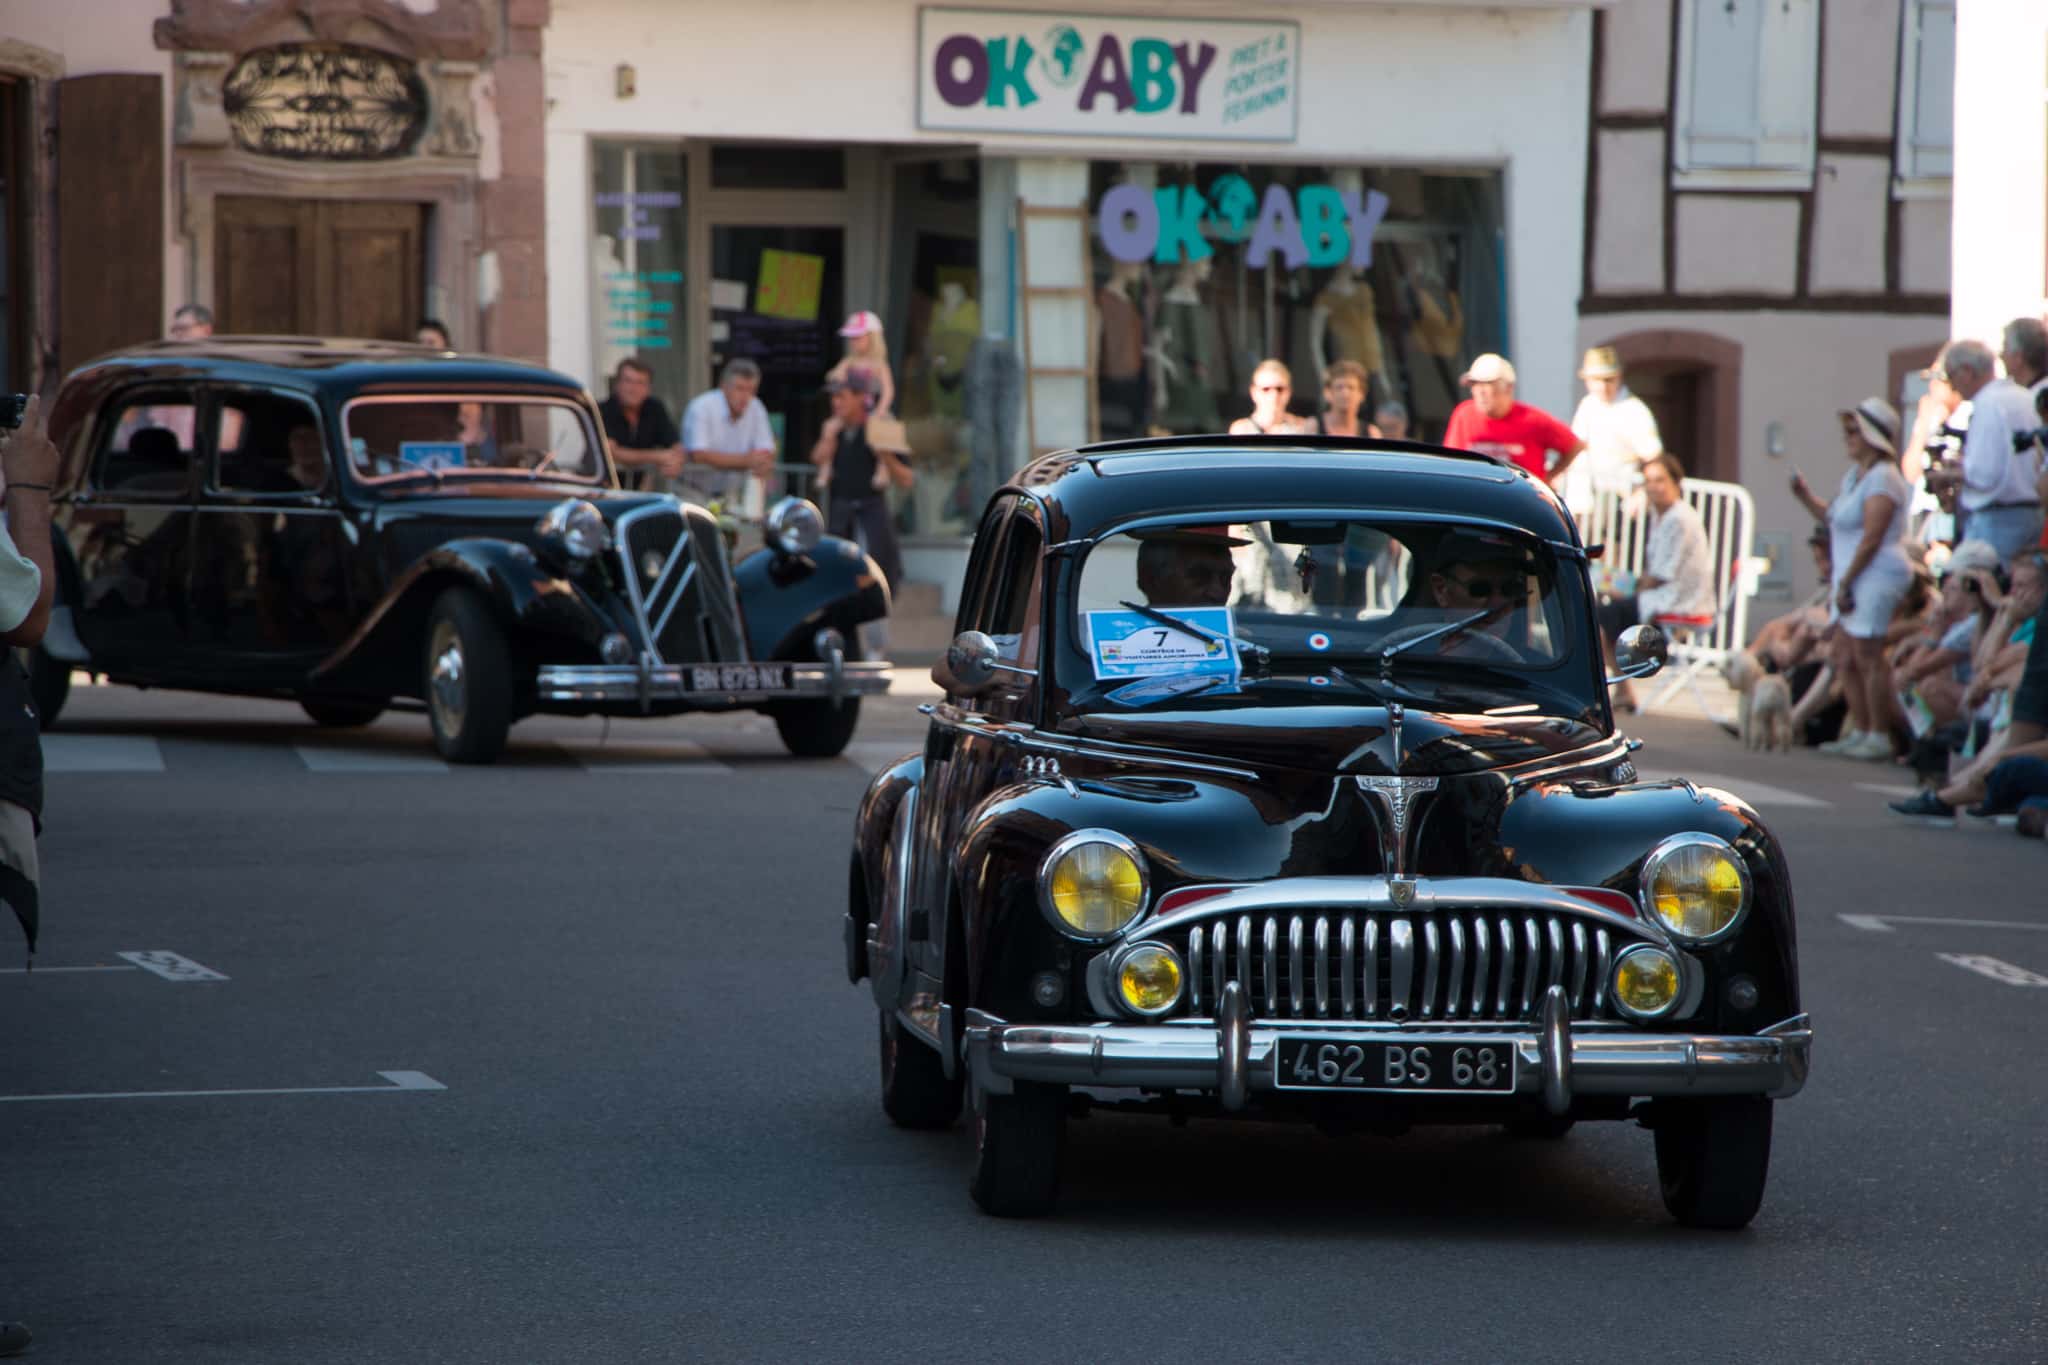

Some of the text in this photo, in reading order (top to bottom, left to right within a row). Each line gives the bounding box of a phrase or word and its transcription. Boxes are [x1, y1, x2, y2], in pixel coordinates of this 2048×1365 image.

[933, 33, 1218, 115] OK ABY
[1100, 183, 1390, 270] OK ABY
[1153, 631, 1169, 647] 7
[1293, 1043, 1498, 1085] 462 BS 68
